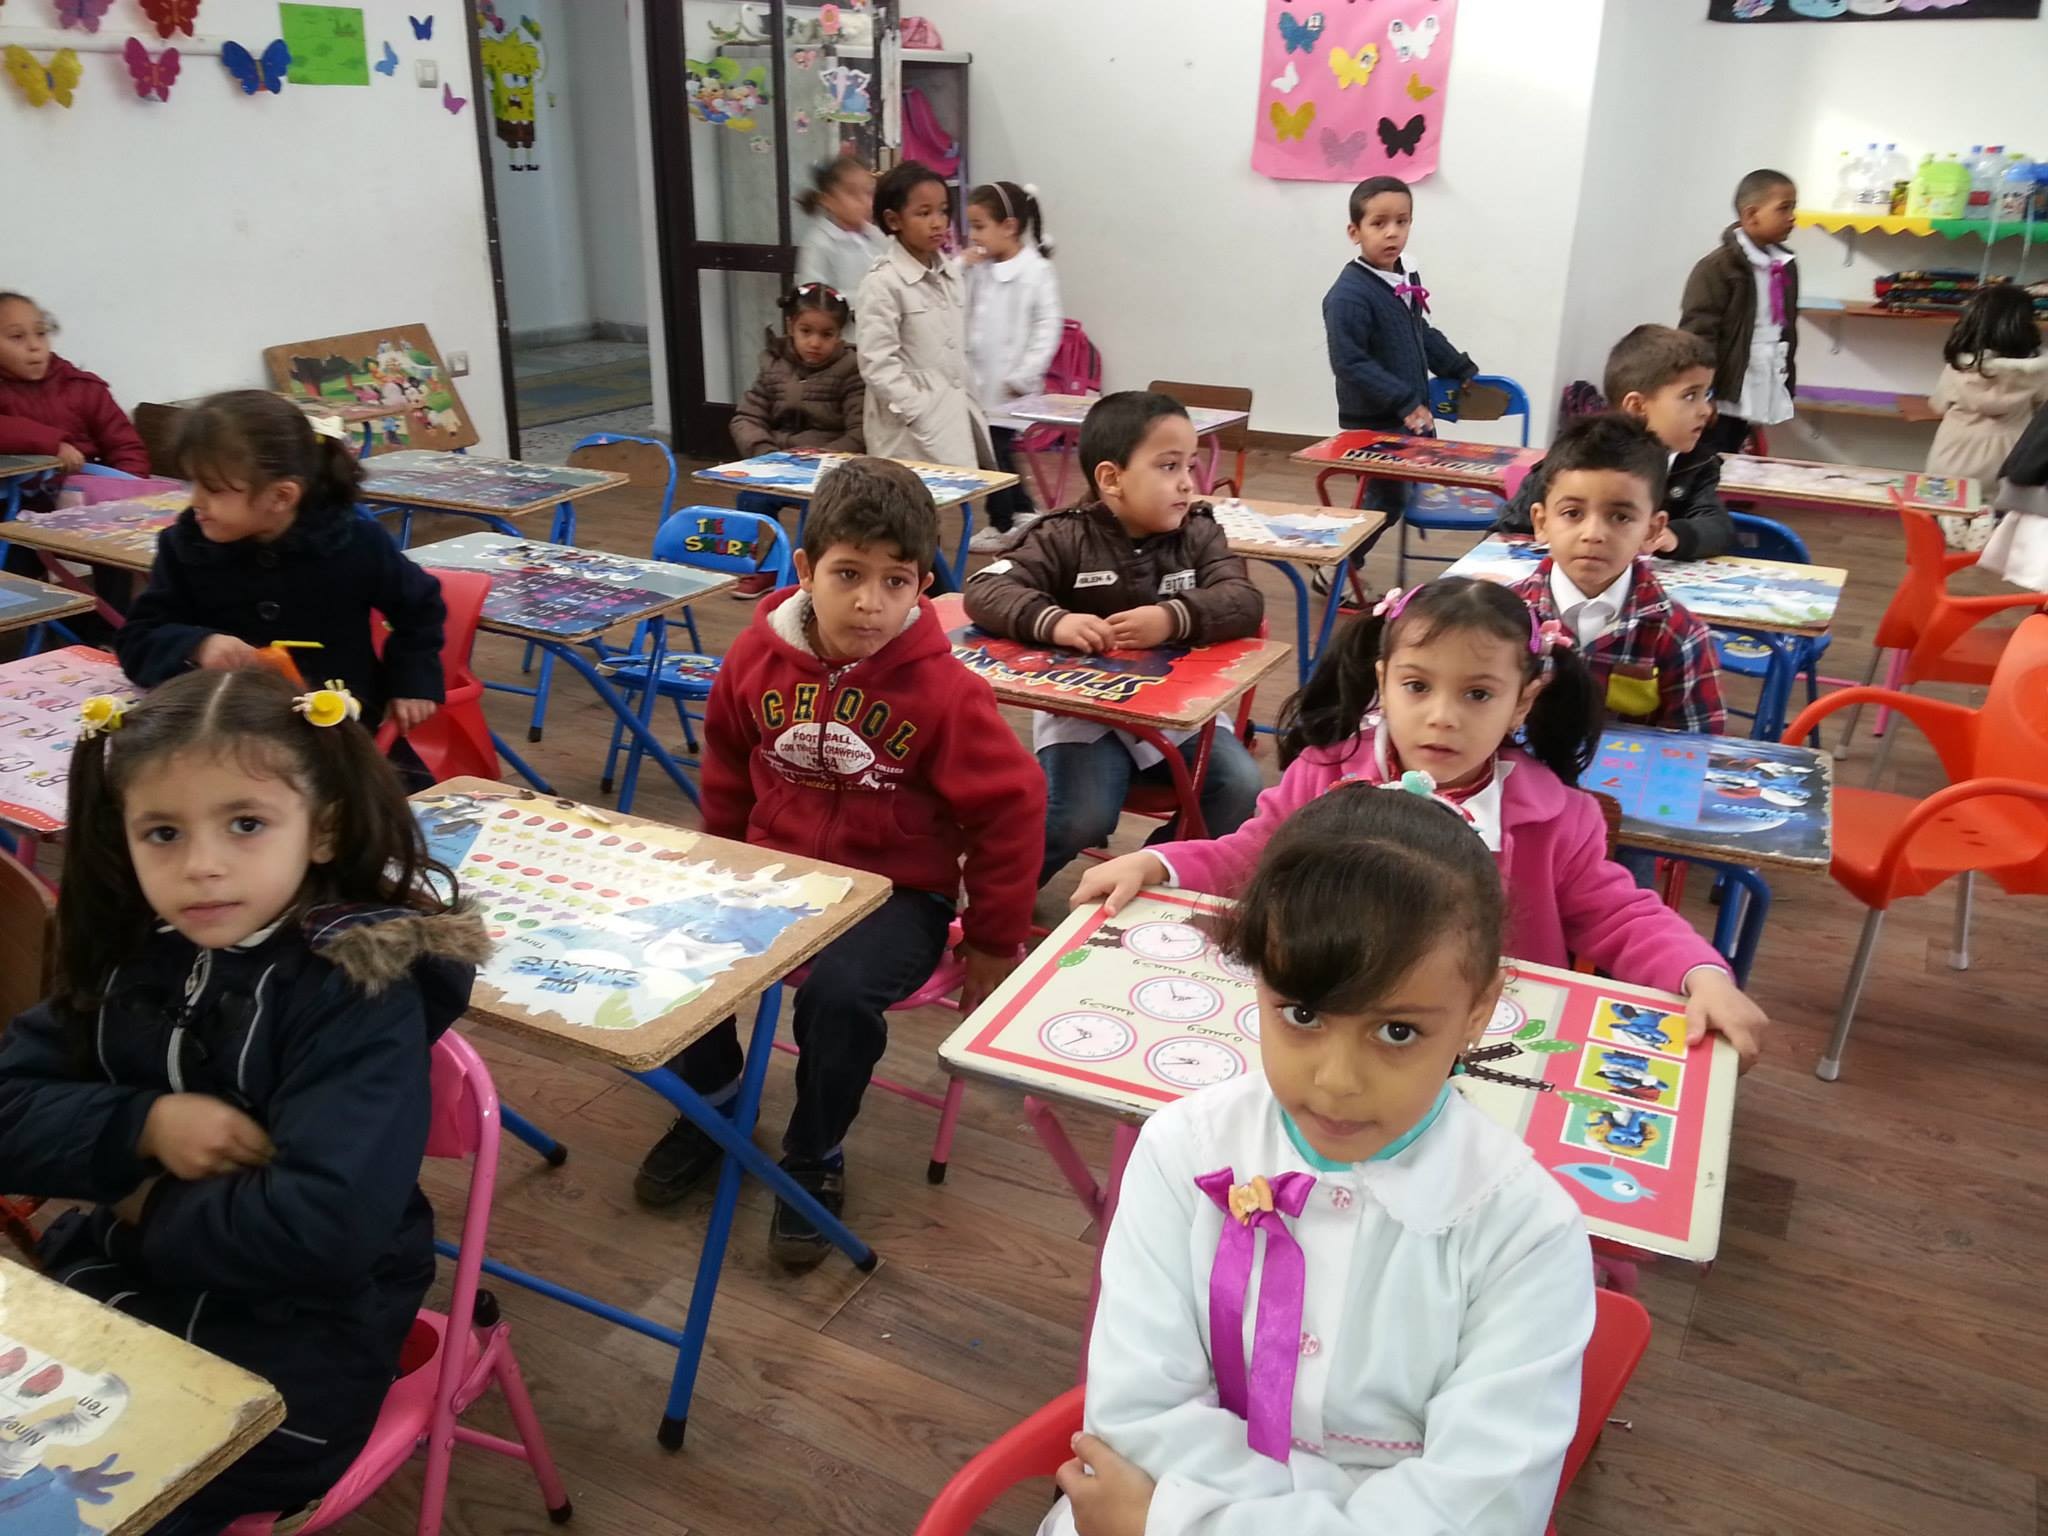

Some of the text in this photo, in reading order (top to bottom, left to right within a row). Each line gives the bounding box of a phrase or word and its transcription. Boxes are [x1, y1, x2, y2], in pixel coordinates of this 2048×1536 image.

[696, 518, 724, 534] THE
[753, 683, 918, 760] CHOOL
[78, 1396, 109, 1418] Ten
[7, 1416, 46, 1447] Nine
